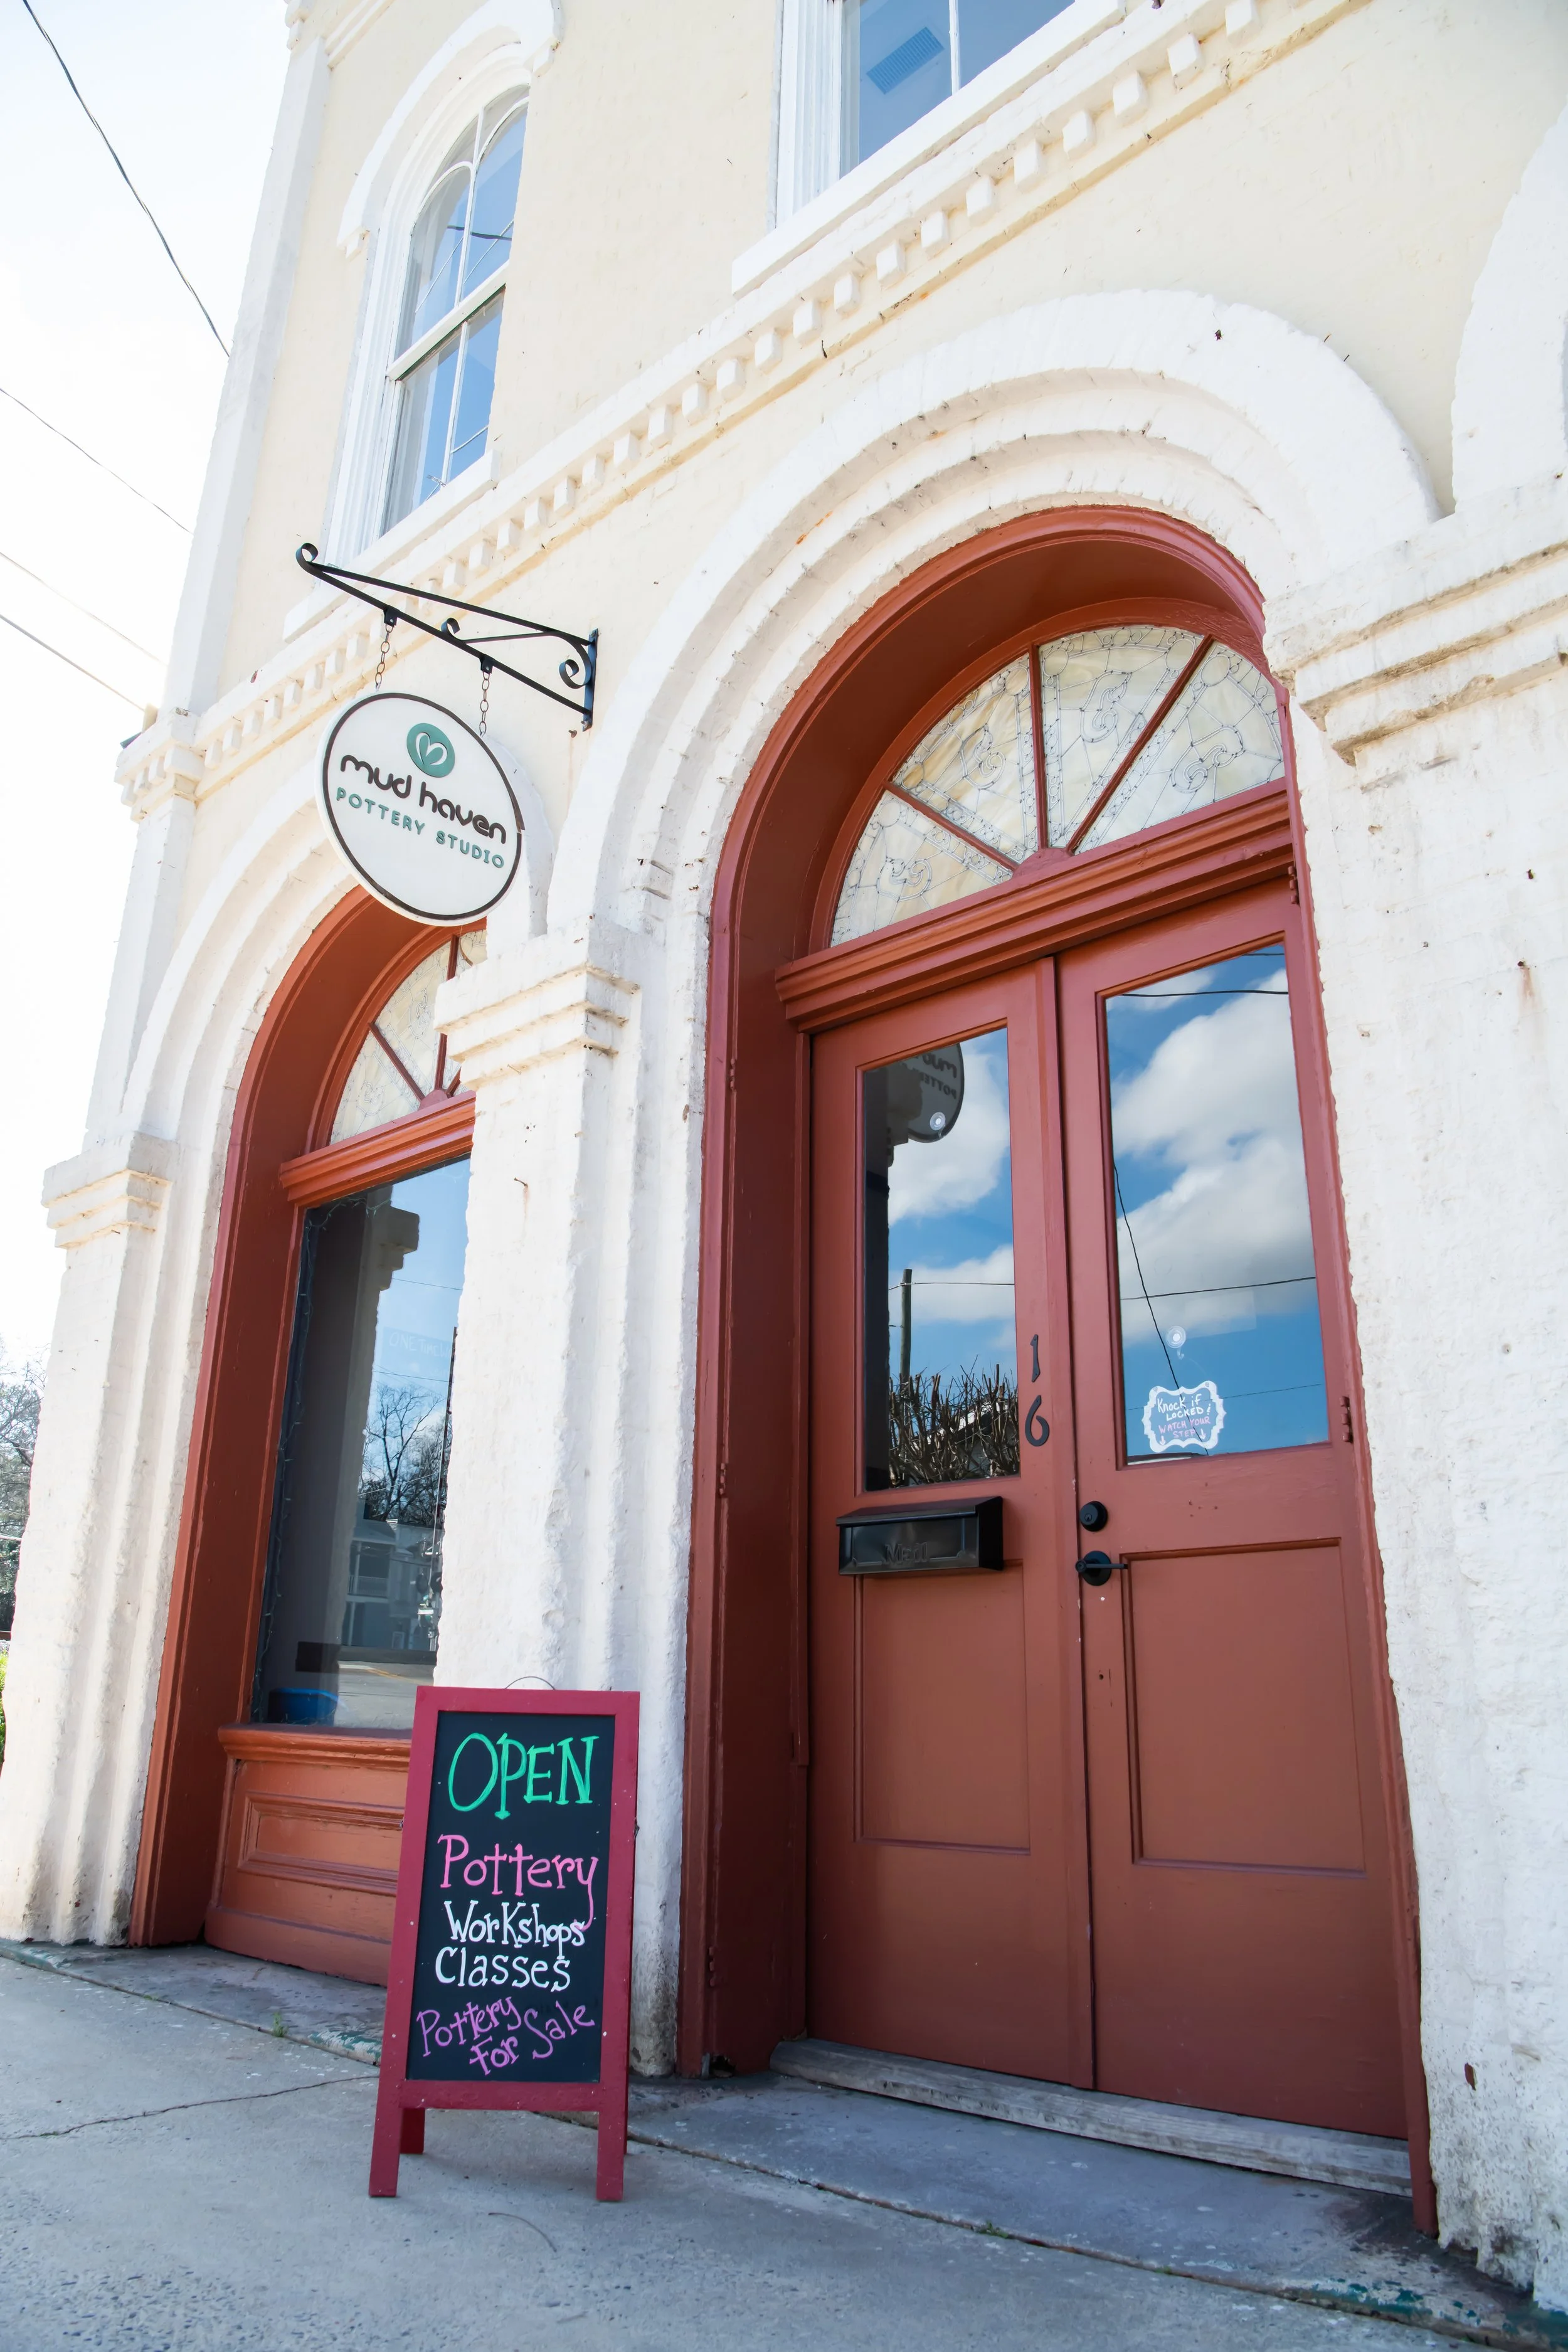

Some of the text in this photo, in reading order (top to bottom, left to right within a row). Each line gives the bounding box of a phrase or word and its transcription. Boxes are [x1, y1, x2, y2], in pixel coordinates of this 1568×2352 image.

[336, 787, 504, 868] POTTERY STUDIO
[340, 755, 507, 844] mud haven
[1158, 1416, 1210, 1434] WATCH YOUR
[1192, 1393, 1202, 1407] if
[1173, 1429, 1196, 1438] STEP
[882, 1542, 928, 1565] Mail
[448, 1732, 600, 1820] OPEN
[438, 1834, 598, 1932] Pottery
[435, 1946, 570, 1992] Classes
[416, 1996, 521, 2057] Pottery
[524, 2000, 595, 2059] Sale
